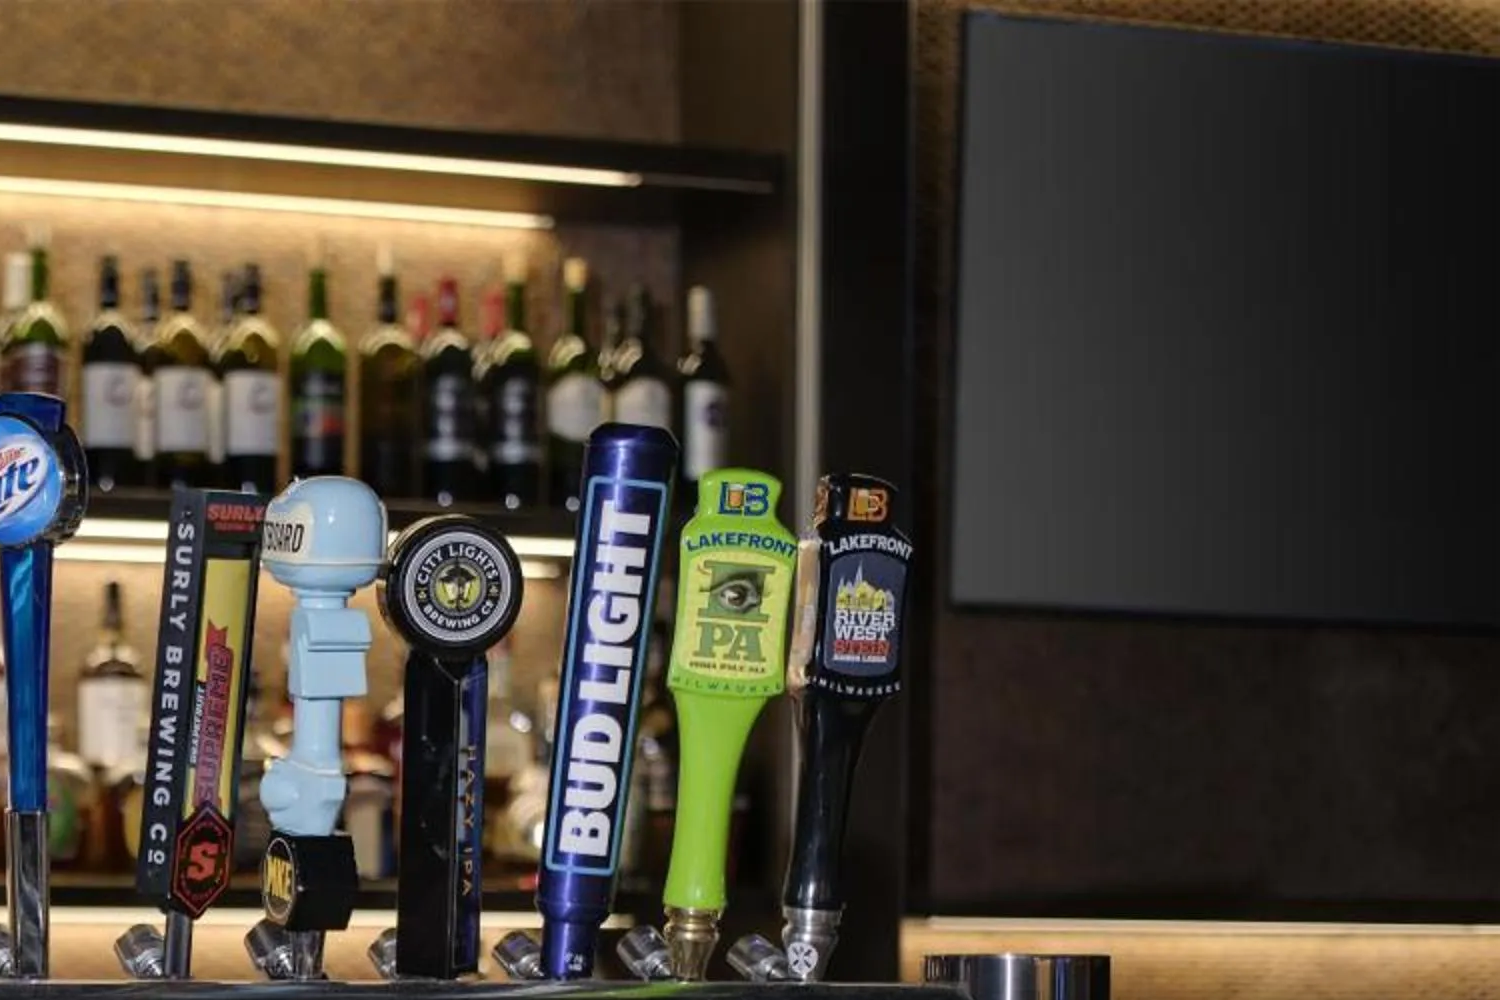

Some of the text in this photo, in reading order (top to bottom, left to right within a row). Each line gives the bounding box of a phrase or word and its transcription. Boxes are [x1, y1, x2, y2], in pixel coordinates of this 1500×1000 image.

[417, 543, 499, 585] CITY LIGHTS
[686, 531, 797, 557] LAKEFRONT
[828, 533, 914, 560] LAKEFRONT
[169, 521, 195, 633] SURLY
[423, 603, 481, 629] BREWING
[833, 609, 896, 629] RIVER
[834, 625, 890, 641] WEST
[692, 621, 767, 663] PA
[558, 499, 651, 858] BUD LIGHT
[152, 646, 185, 806] BREWING
[463, 745, 477, 897] HAZY IPA
